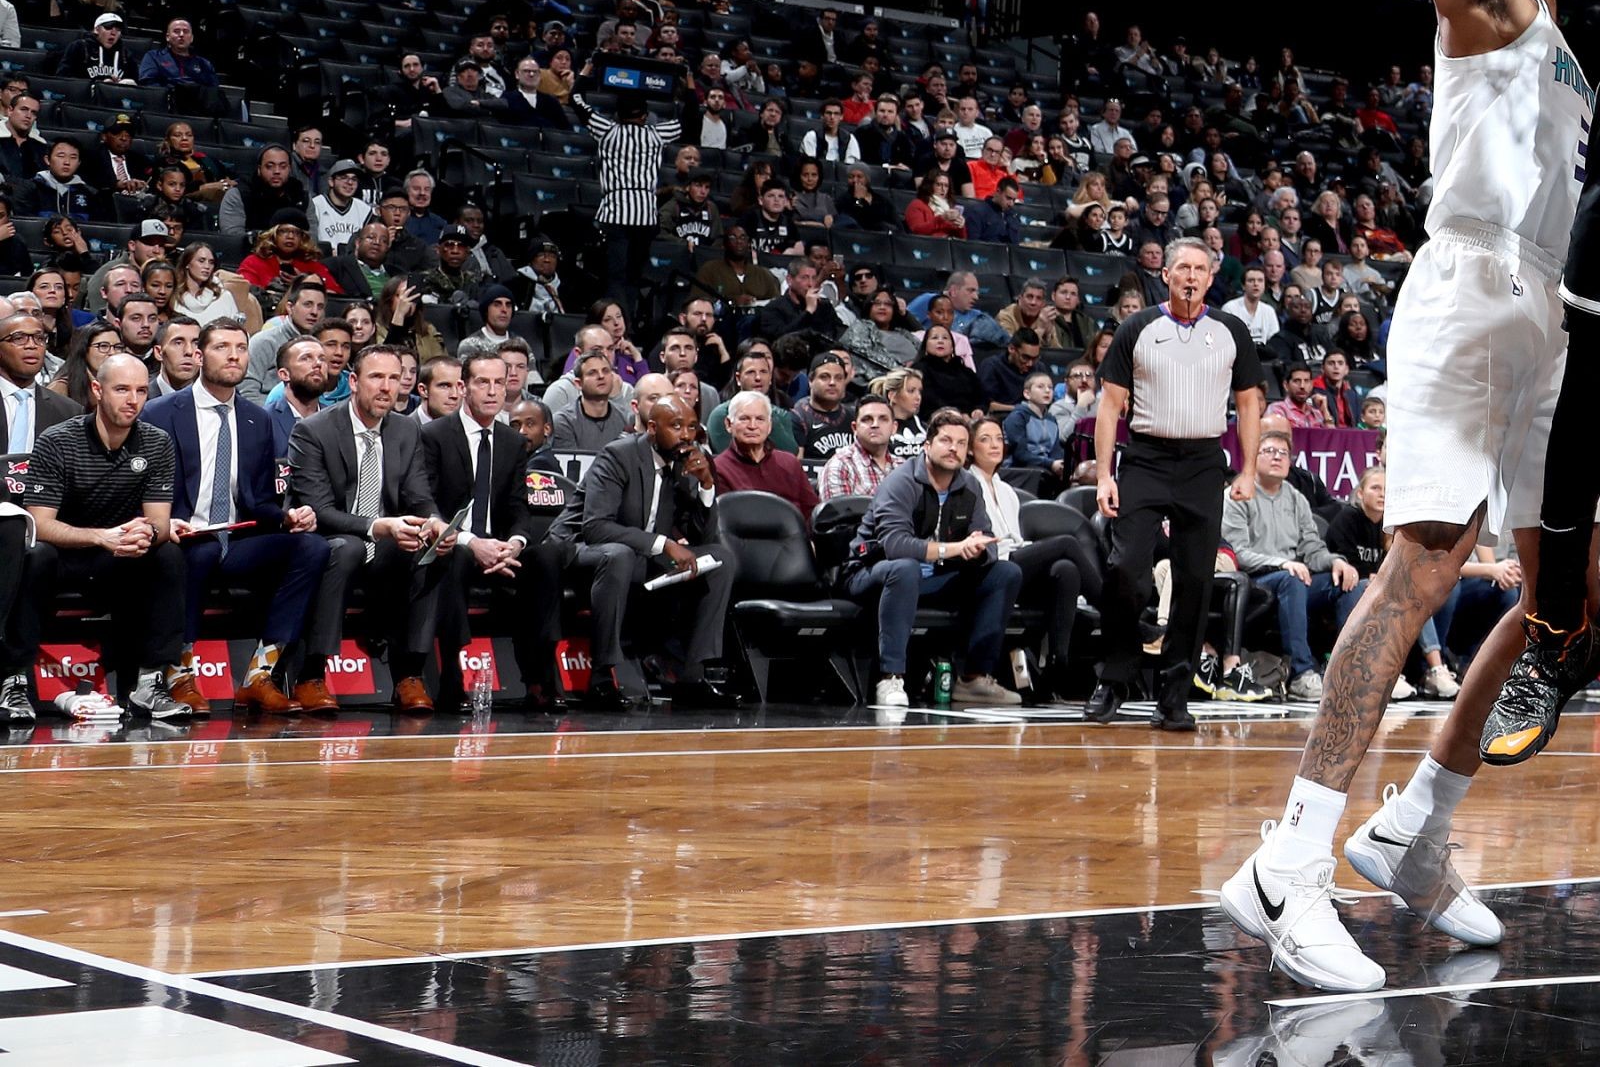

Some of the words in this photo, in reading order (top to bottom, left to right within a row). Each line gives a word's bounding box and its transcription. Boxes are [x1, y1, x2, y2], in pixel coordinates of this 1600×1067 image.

[5, 477, 26, 495] Re
[41, 656, 100, 678] infor
[192, 655, 227, 677] for
[459, 650, 492, 671] for
[560, 651, 593, 671] inf
